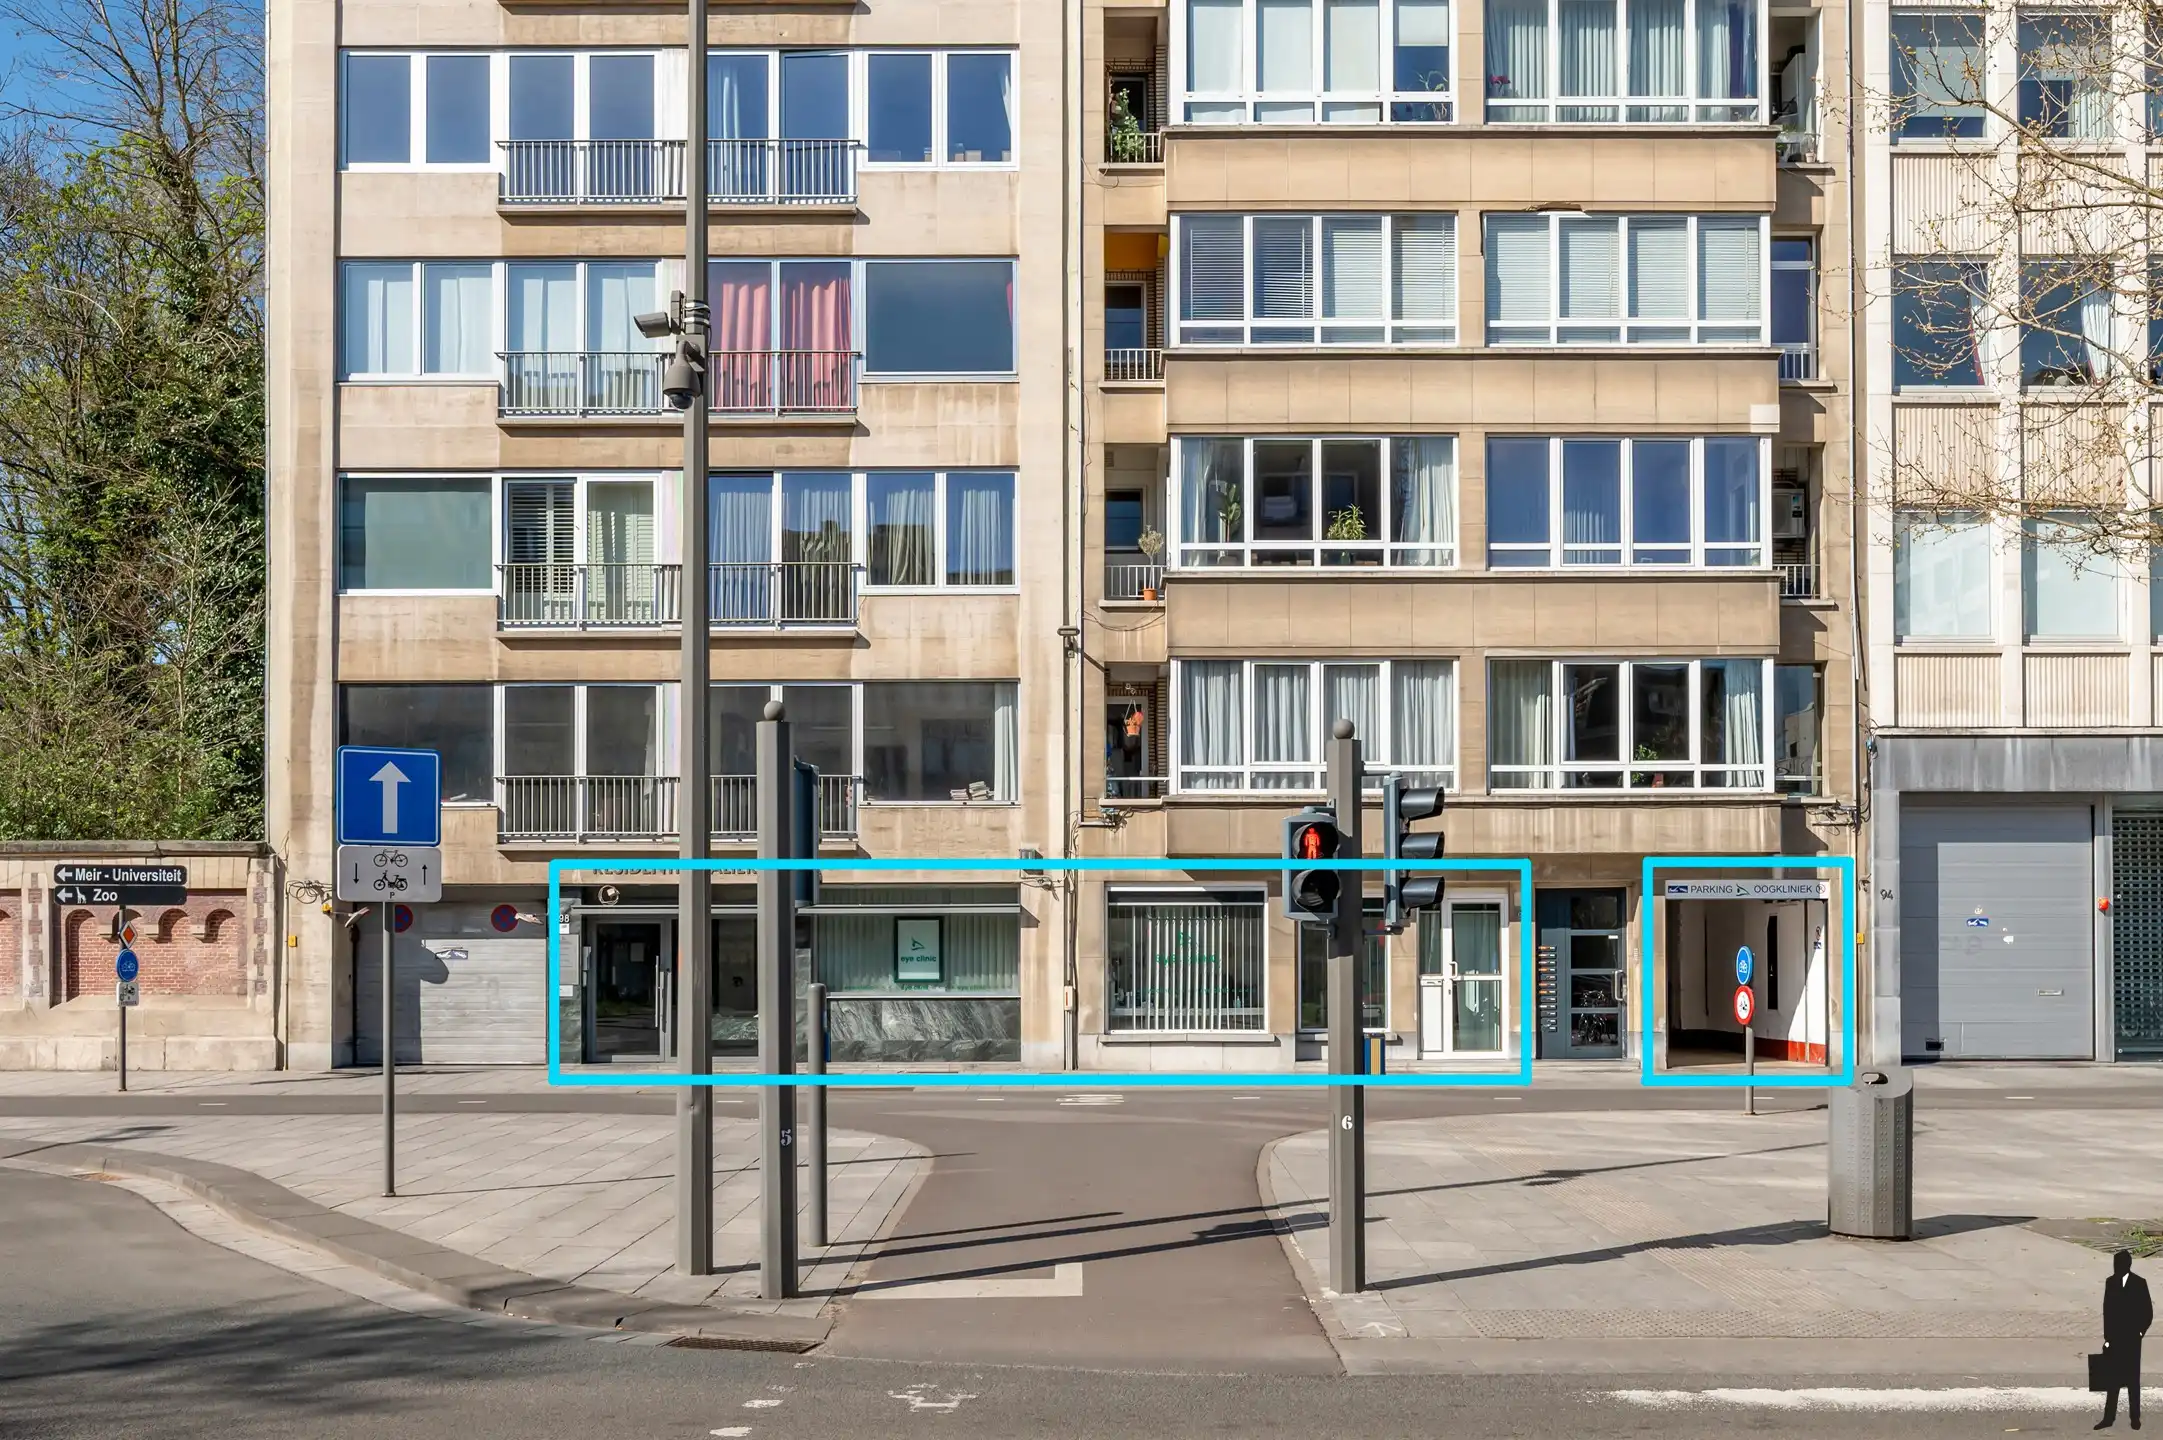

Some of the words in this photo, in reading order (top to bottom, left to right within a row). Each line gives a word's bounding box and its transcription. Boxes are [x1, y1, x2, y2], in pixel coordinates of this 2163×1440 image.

[75, 868, 102, 881] Meir
[112, 868, 182, 882] Universiteit
[93, 888, 118, 902] Zoo
[389, 891, 396, 899] P
[1690, 884, 1733, 894] PARKING
[1753, 884, 1813, 894] OOGKLINIEK
[1880, 888, 1894, 900] 94
[1341, 1114, 1353, 1130] 6
[780, 1128, 792, 1146] 5
